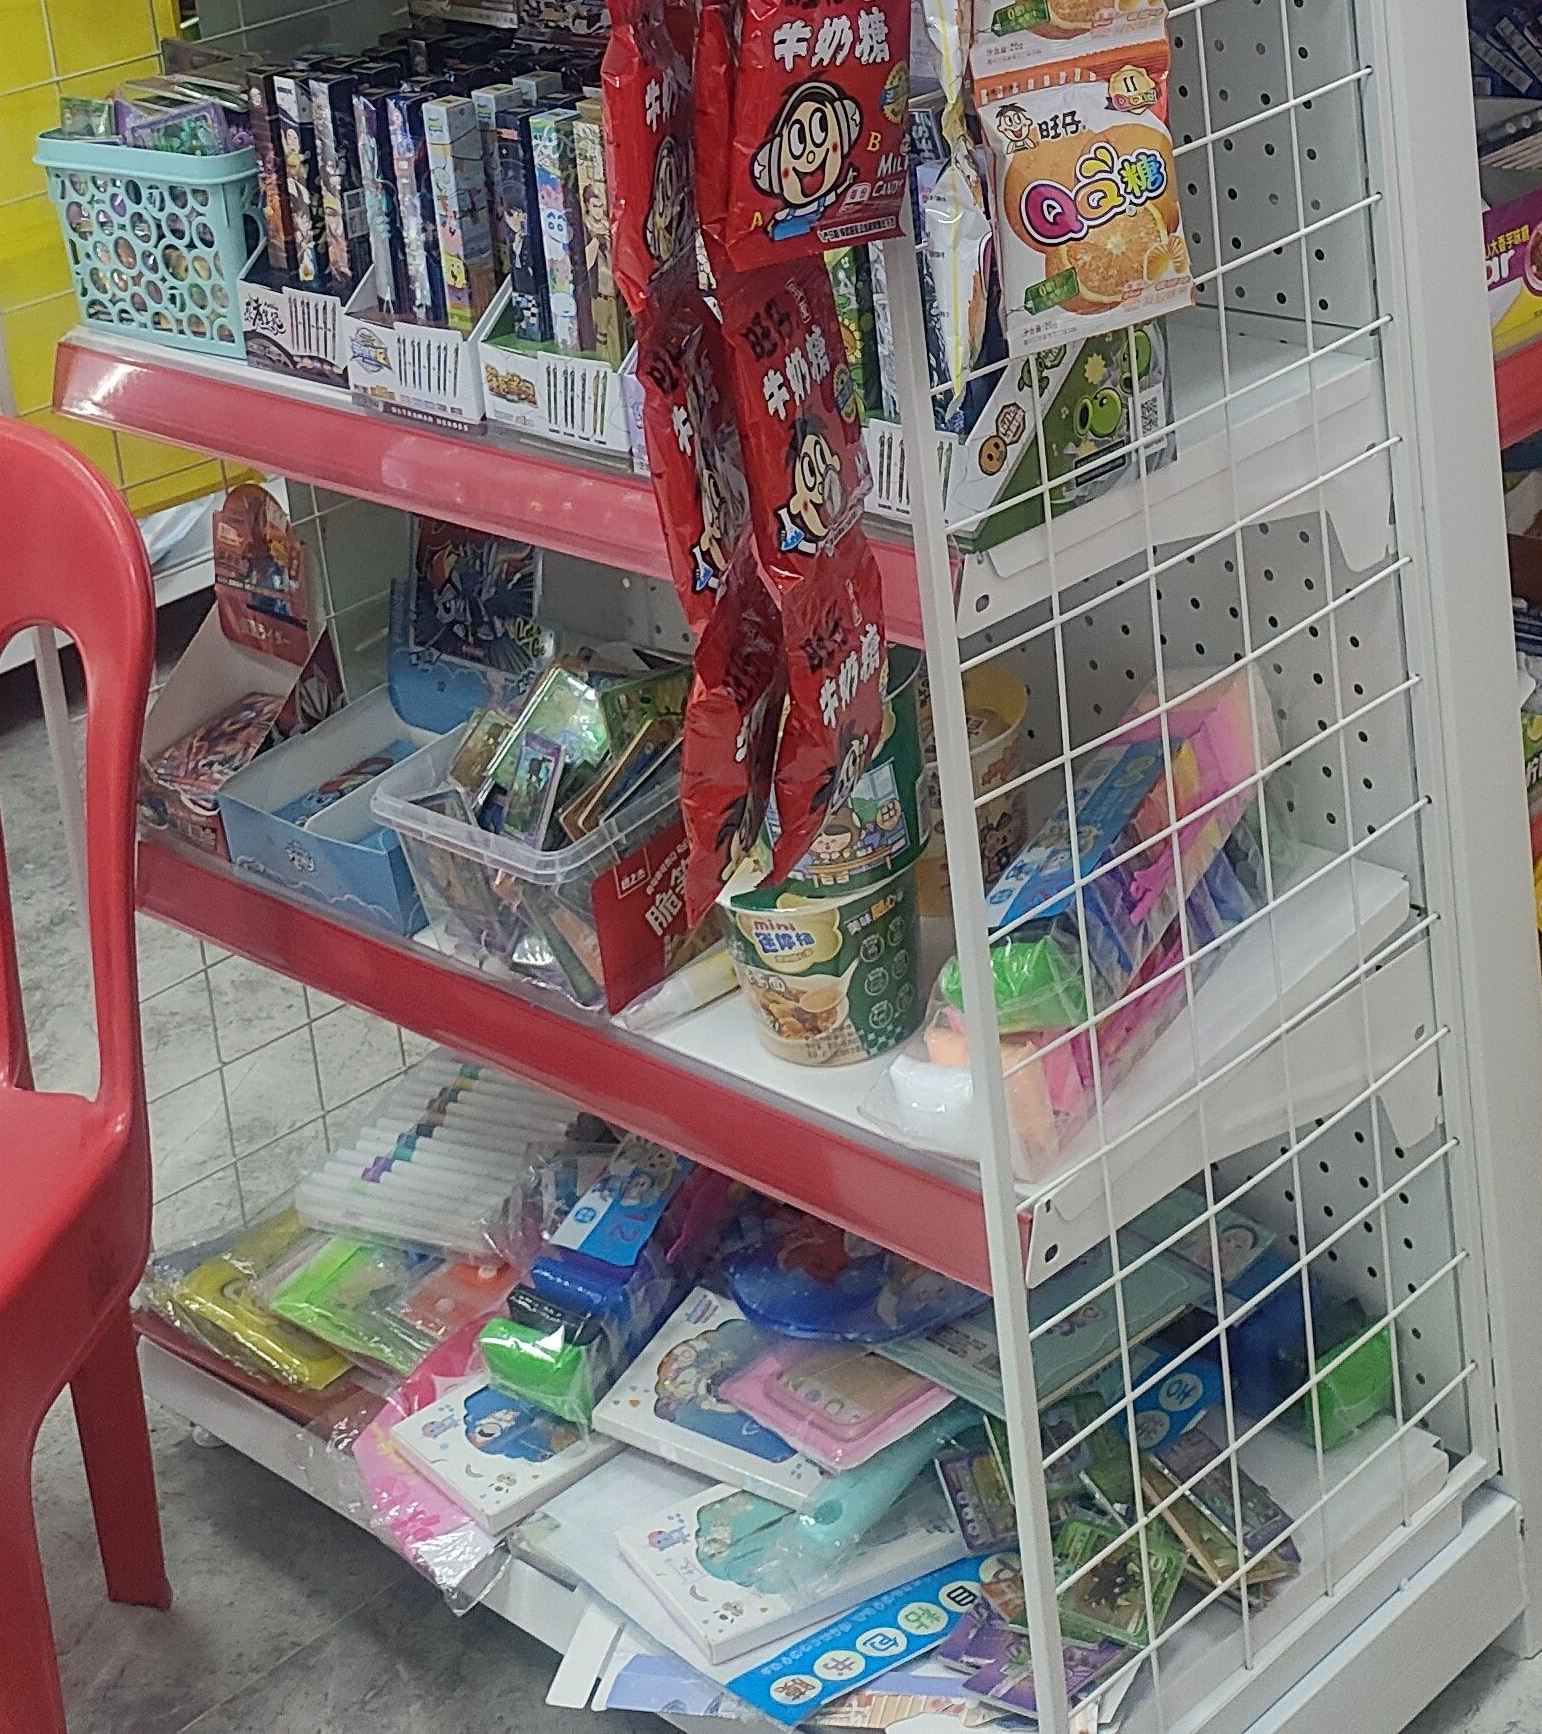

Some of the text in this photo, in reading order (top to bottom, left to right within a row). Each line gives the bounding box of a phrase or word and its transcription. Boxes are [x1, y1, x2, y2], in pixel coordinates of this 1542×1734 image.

[772, 10, 890, 72] 牛奶糖
[1037, 110, 1083, 143] 旺仔
[1021, 150, 1168, 246] QQ糖
